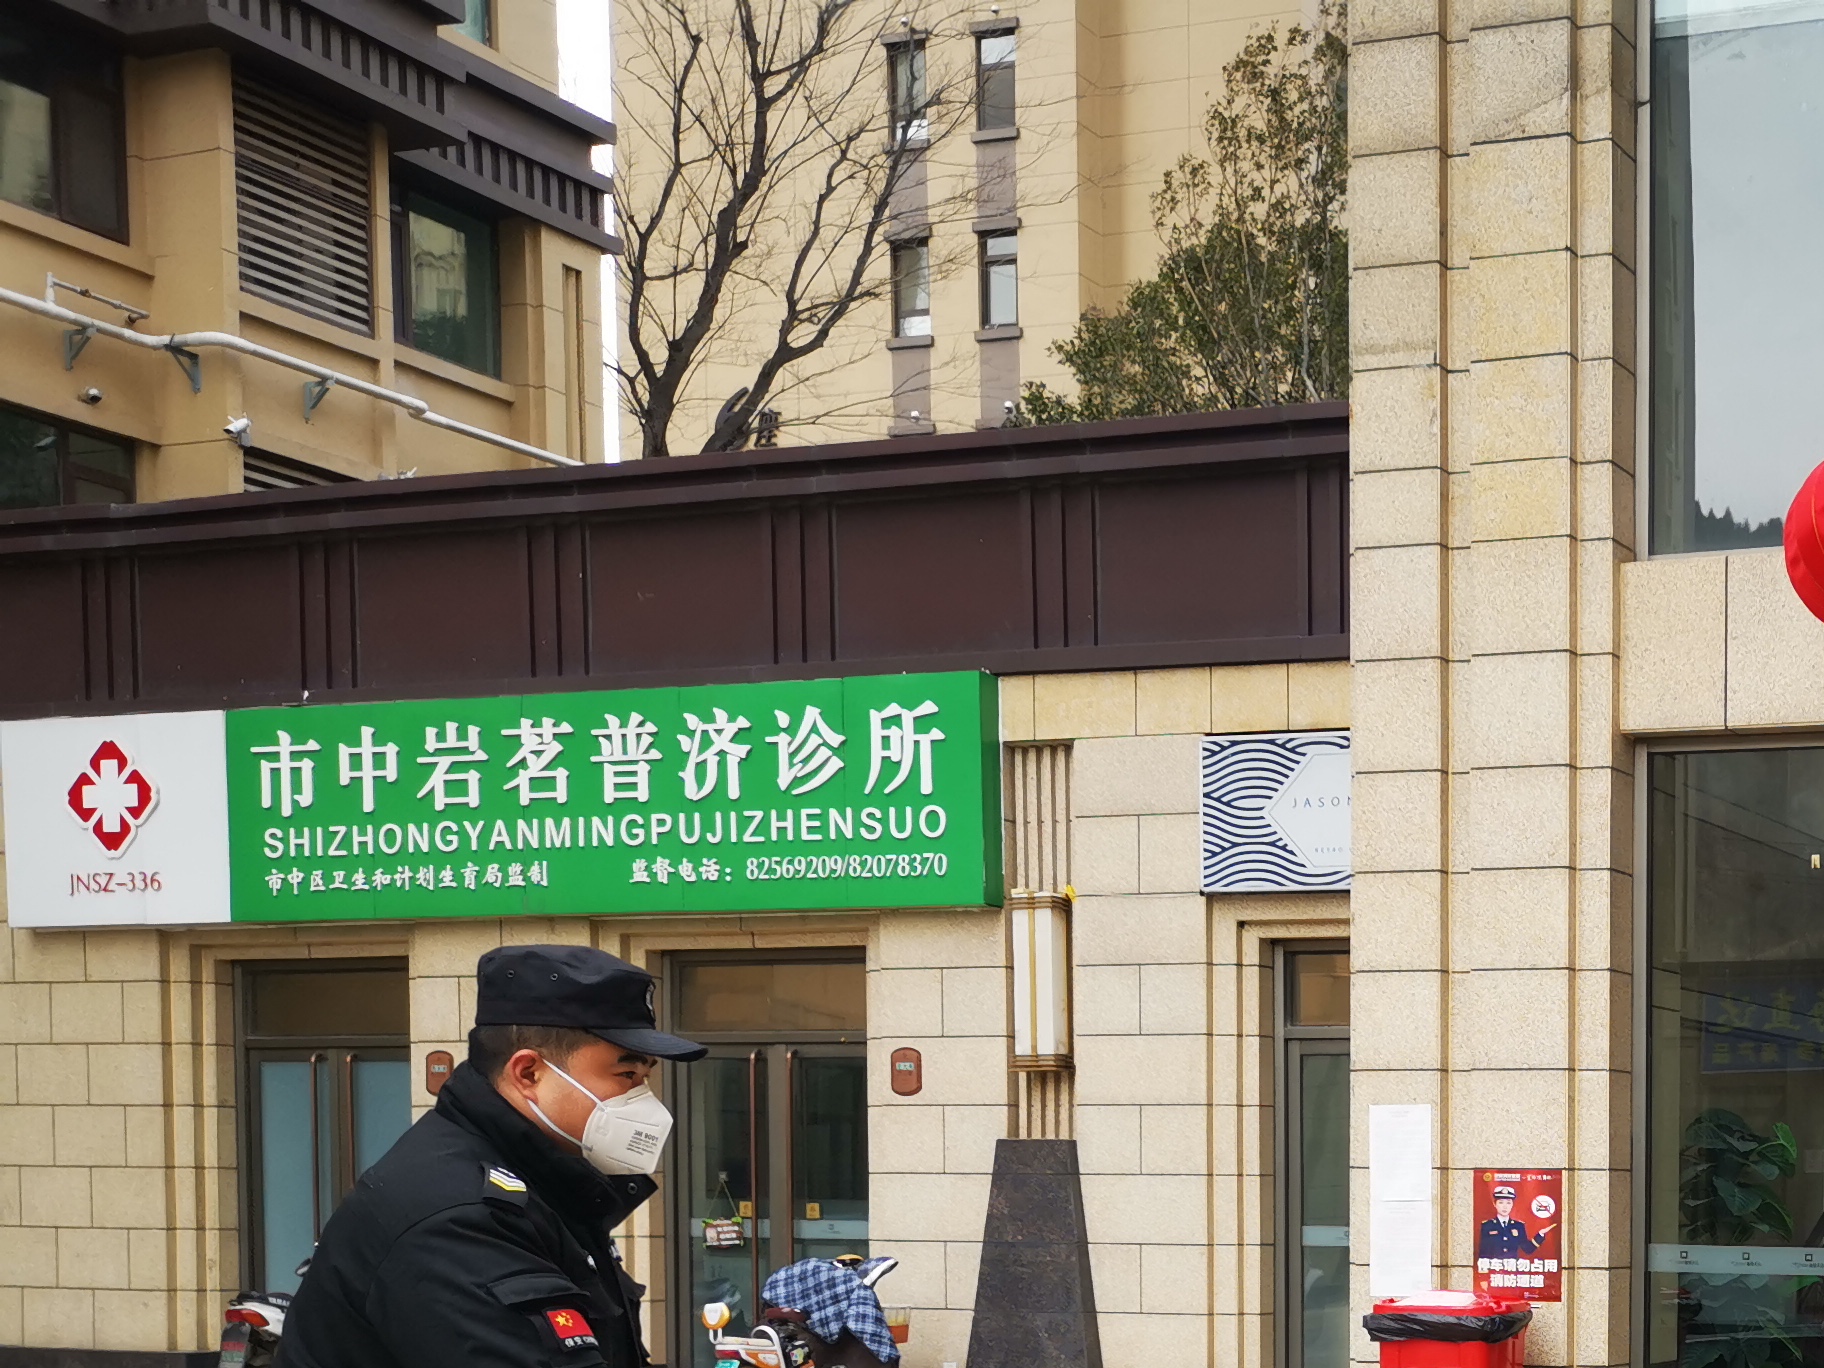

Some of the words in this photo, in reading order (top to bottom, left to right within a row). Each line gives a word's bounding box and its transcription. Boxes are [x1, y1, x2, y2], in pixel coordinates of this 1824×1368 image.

[250, 700, 947, 818] 市中岩茗普济诊所
[263, 804, 948, 858] SHIZHONGYANMINGPUJIZHENSUO
[69, 871, 162, 897] JNSZ-336
[264, 860, 549, 897] 市中区卫生和计划生育局监制
[1477, 1257, 1558, 1274] 停车请勿占用
[1490, 1274, 1545, 1288] 消防通道
